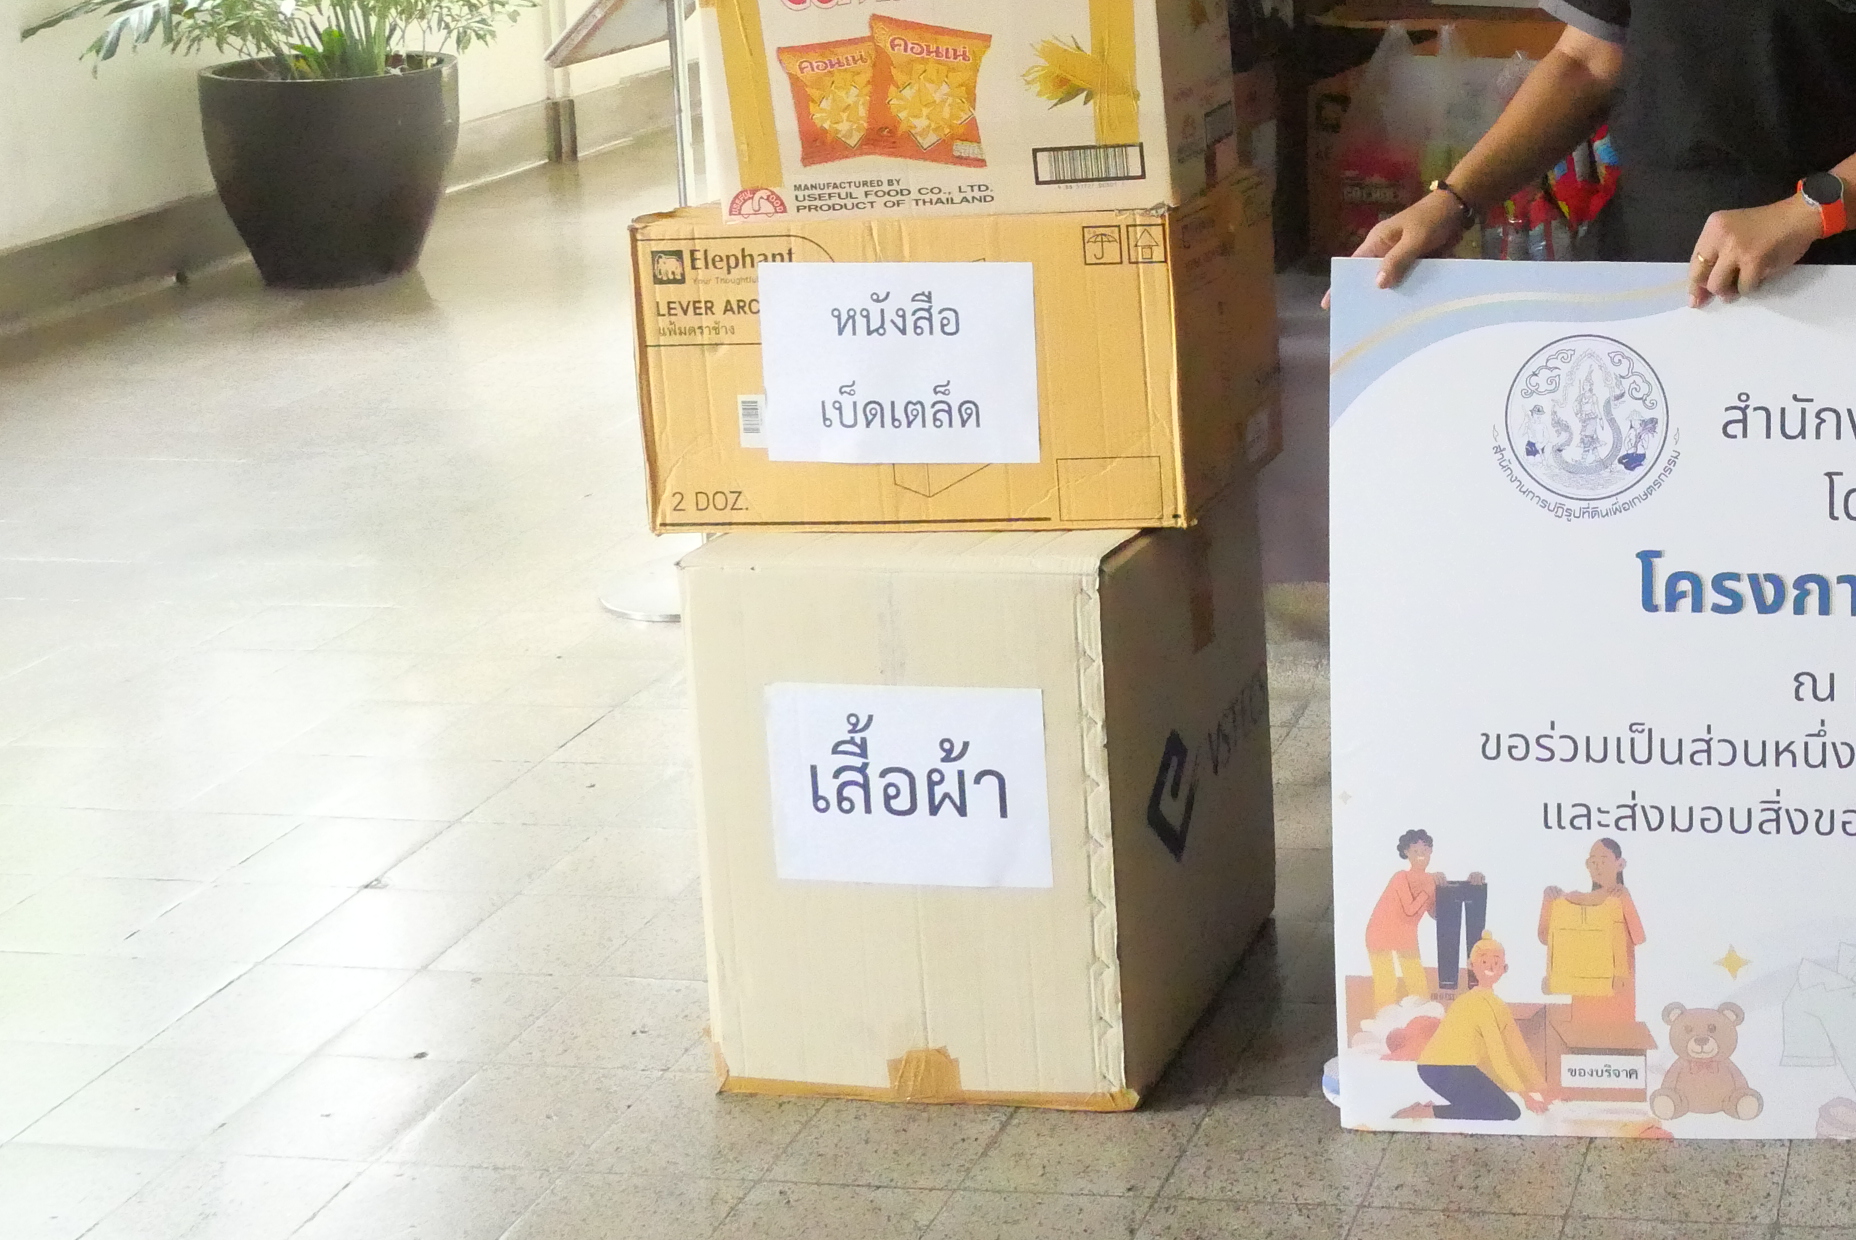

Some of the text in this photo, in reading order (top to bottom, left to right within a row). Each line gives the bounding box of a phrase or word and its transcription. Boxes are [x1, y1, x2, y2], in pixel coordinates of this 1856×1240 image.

[793, 178, 902, 192] MANUFACTURED BY
[794, 191, 859, 203] USEFUL
[864, 188, 912, 199] FOOD
[957, 183, 994, 194] LTD.
[796, 193, 995, 213] PRODUCT OF THAILAND
[655, 300, 715, 318] LEVER
[830, 289, 961, 338] หนังสือ
[820, 381, 982, 431] เบ็ดเตล็ด
[671, 490, 750, 513] 2 DOZ.
[1793, 667, 1837, 704] ณ
[809, 711, 1009, 819] เสื้อผ้า
[1566, 1062, 1639, 1080] ของบริจาค
